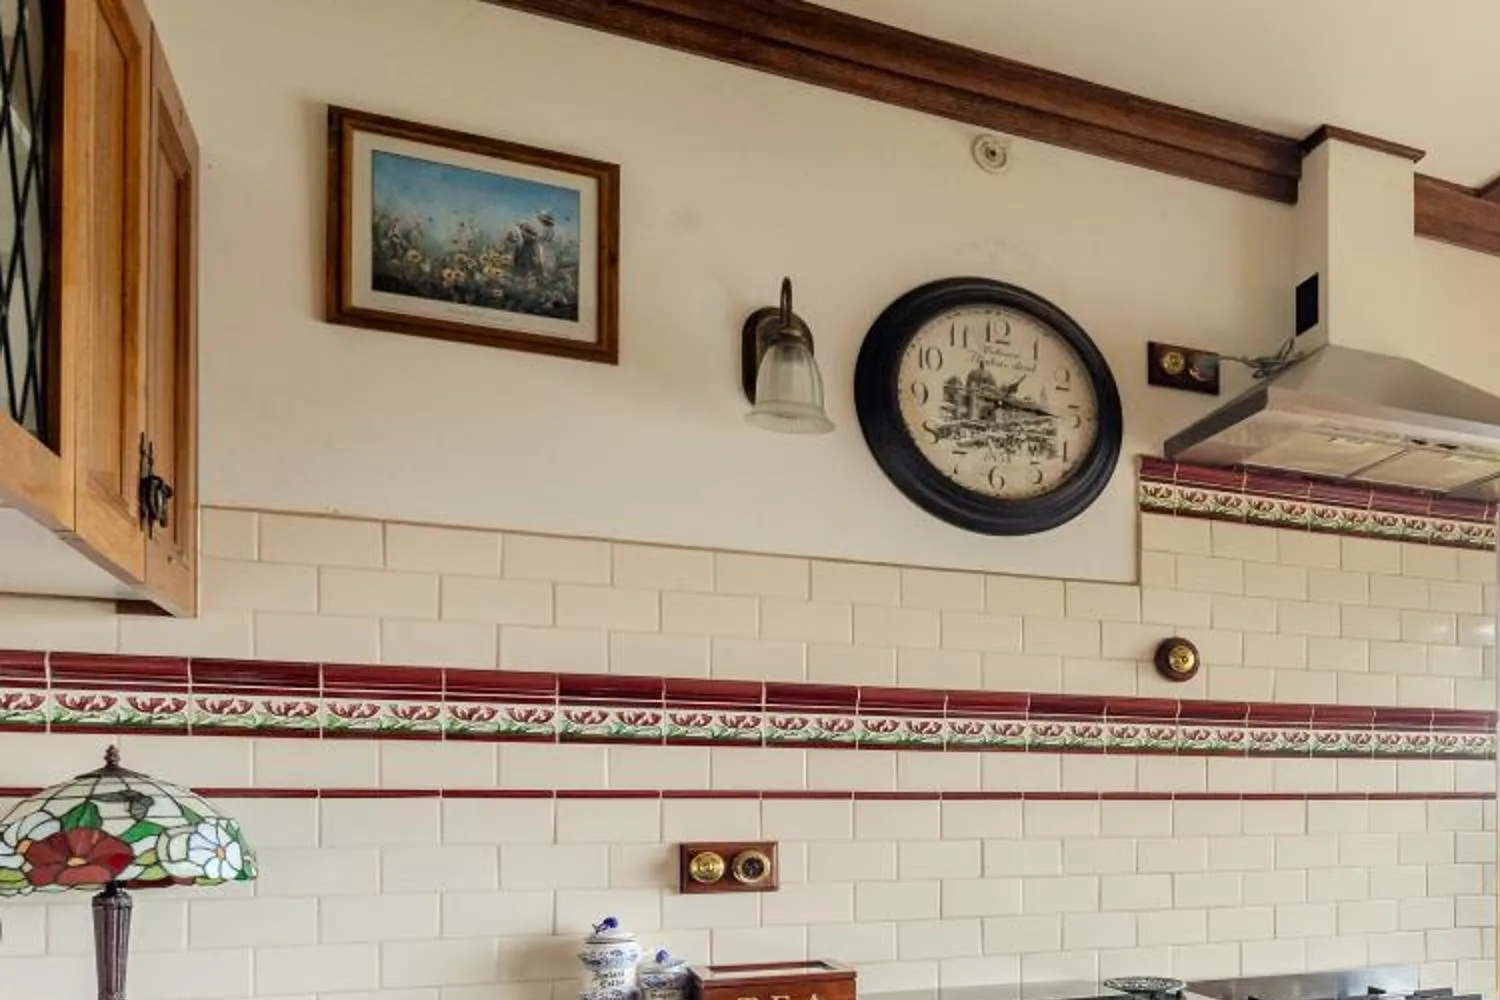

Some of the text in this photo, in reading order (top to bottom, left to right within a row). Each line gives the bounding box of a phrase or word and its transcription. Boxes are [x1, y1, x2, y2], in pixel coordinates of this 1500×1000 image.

[950, 322, 968, 348] 11
[985, 320, 1011, 345] 12
[918, 346, 943, 370] 10
[1053, 367, 1071, 392] 2
[910, 381, 929, 405] 9
[988, 465, 1006, 490] 6
[1028, 460, 1044, 485] 5
